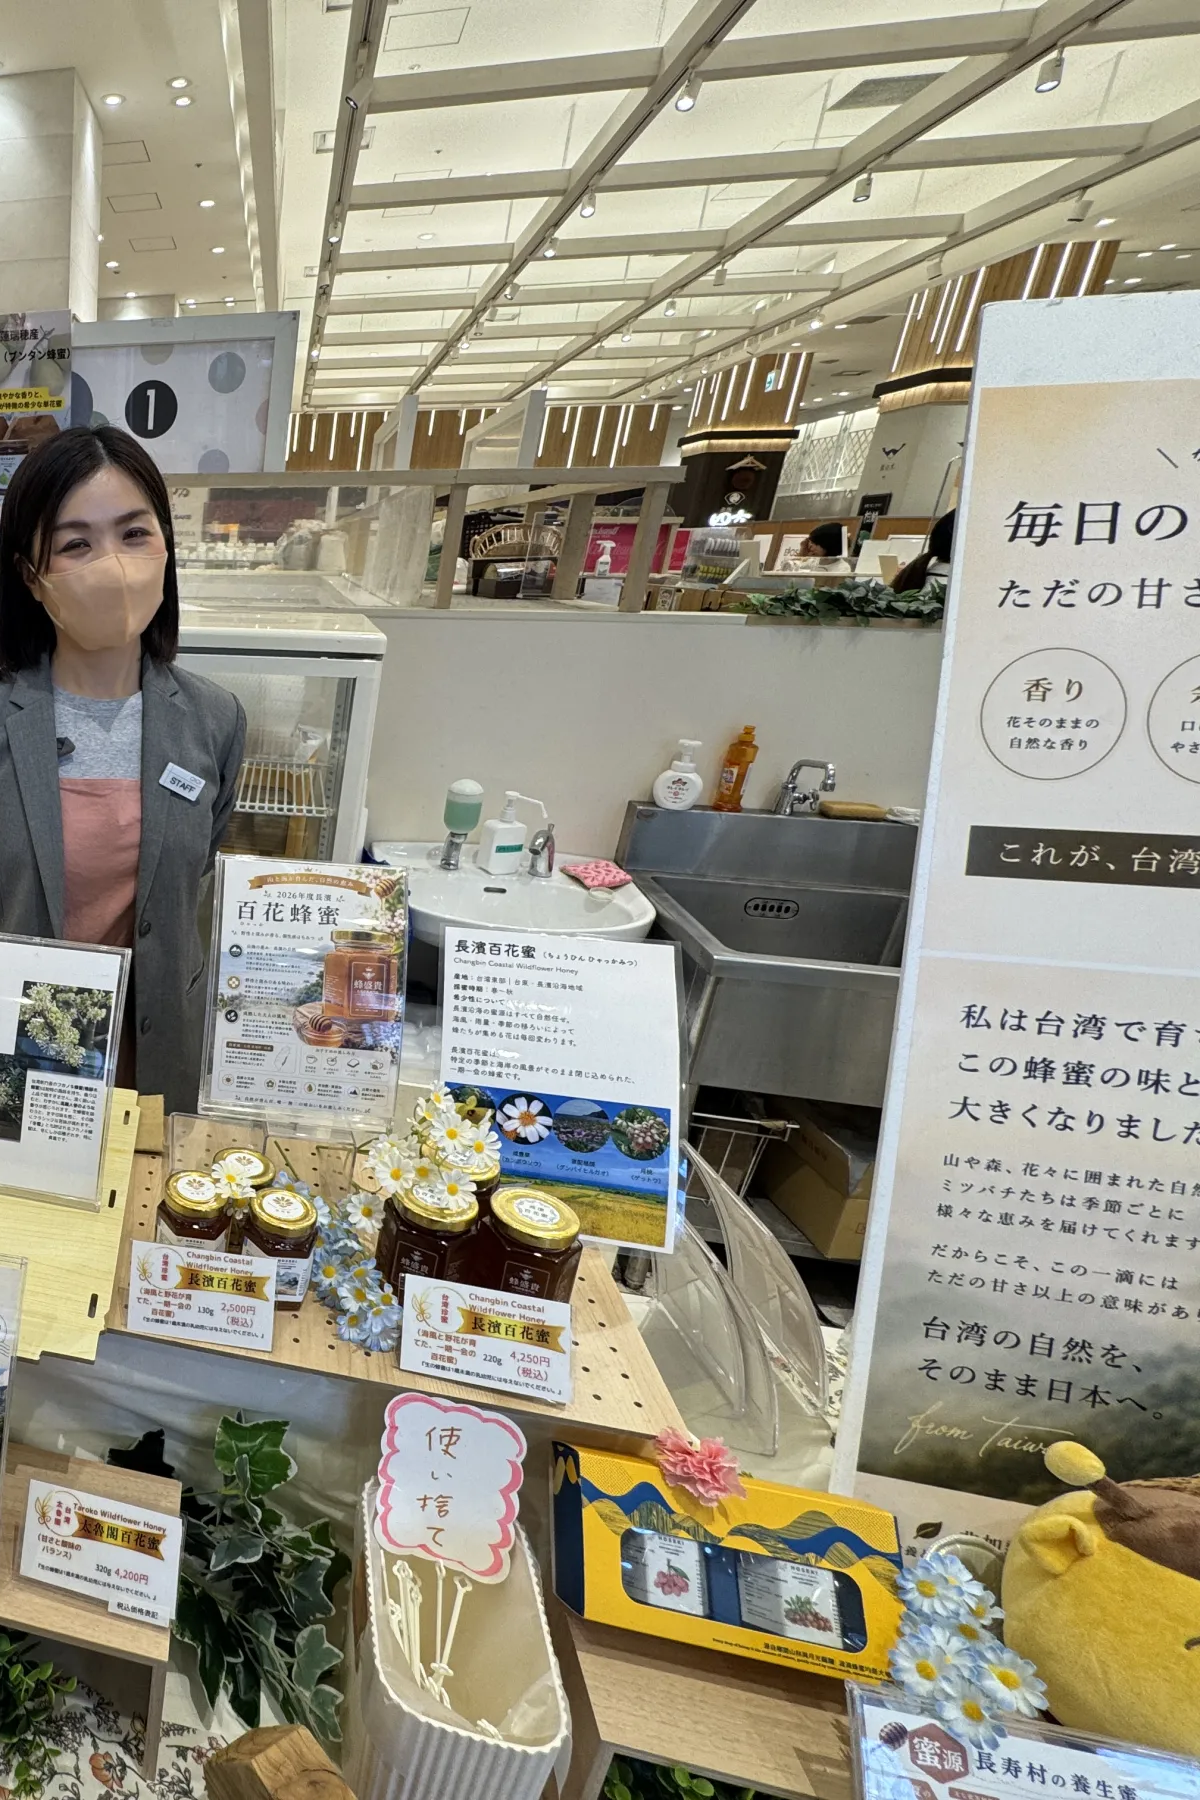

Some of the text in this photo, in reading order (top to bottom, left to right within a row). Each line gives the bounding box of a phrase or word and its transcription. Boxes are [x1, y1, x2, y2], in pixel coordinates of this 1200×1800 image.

[147, 389, 155, 430] 1
[1004, 500, 1188, 547] 毎日の
[1022, 677, 1083, 702] 香り
[1006, 716, 1100, 729] 花そのままの
[1009, 738, 1088, 751] 自然な香り
[170, 777, 196, 793] STAFF
[1000, 842, 1200, 875] これが、台湾
[237, 900, 340, 926] 百花蜂蜜
[455, 940, 536, 958] 長濱百花蜜
[454, 958, 486, 966] Changbin
[516, 963, 553, 972] Wildflower
[556, 967, 578, 975] Honey
[353, 980, 383, 990] 蜂盛貴
[960, 1004, 1200, 1047] 私は台湾で育
[958, 1053, 1200, 1096] この蜂蜜の味と
[942, 1179, 1184, 1222] ミツバチたちは季節ごとに
[186, 1262, 253, 1275] Wildflower Honey
[187, 1252, 253, 1266] Changbin Coastal
[931, 1243, 1178, 1290] だからこそ、この一滴には
[188, 1273, 257, 1293] 長濱百花蜜
[509, 1276, 539, 1292] 蜂盛貴
[469, 1293, 545, 1313] Changbin Coastal
[928, 1270, 1200, 1321] ただの甘さ以上の意味があ
[198, 1303, 255, 1316] 130g 2,500円
[468, 1304, 546, 1324] Wildflower Honey
[226, 1316, 253, 1328] （税込）
[472, 1317, 550, 1344] 長濱百花蜜
[922, 1317, 1146, 1373] 台湾の自然を、
[483, 1351, 550, 1367] 220g 4,250円
[517, 1366, 548, 1381] （税込）
[917, 1357, 1164, 1421] そのまま日本へ。
[894, 1402, 1075, 1458] from Taiw
[417, 1426, 462, 1547] 使い捨て
[73, 1503, 166, 1533] Taroko Wildflower Honey
[79, 1520, 160, 1551] 太魯閣百花蜜
[658, 1536, 685, 1546] HOSEKI
[95, 1564, 148, 1585] 320g 4,200円
[117, 1602, 158, 1619] 税込価格表記
[912, 1736, 964, 1773] 蜜源
[975, 1751, 1138, 1800] 長寿村の養生蜜
